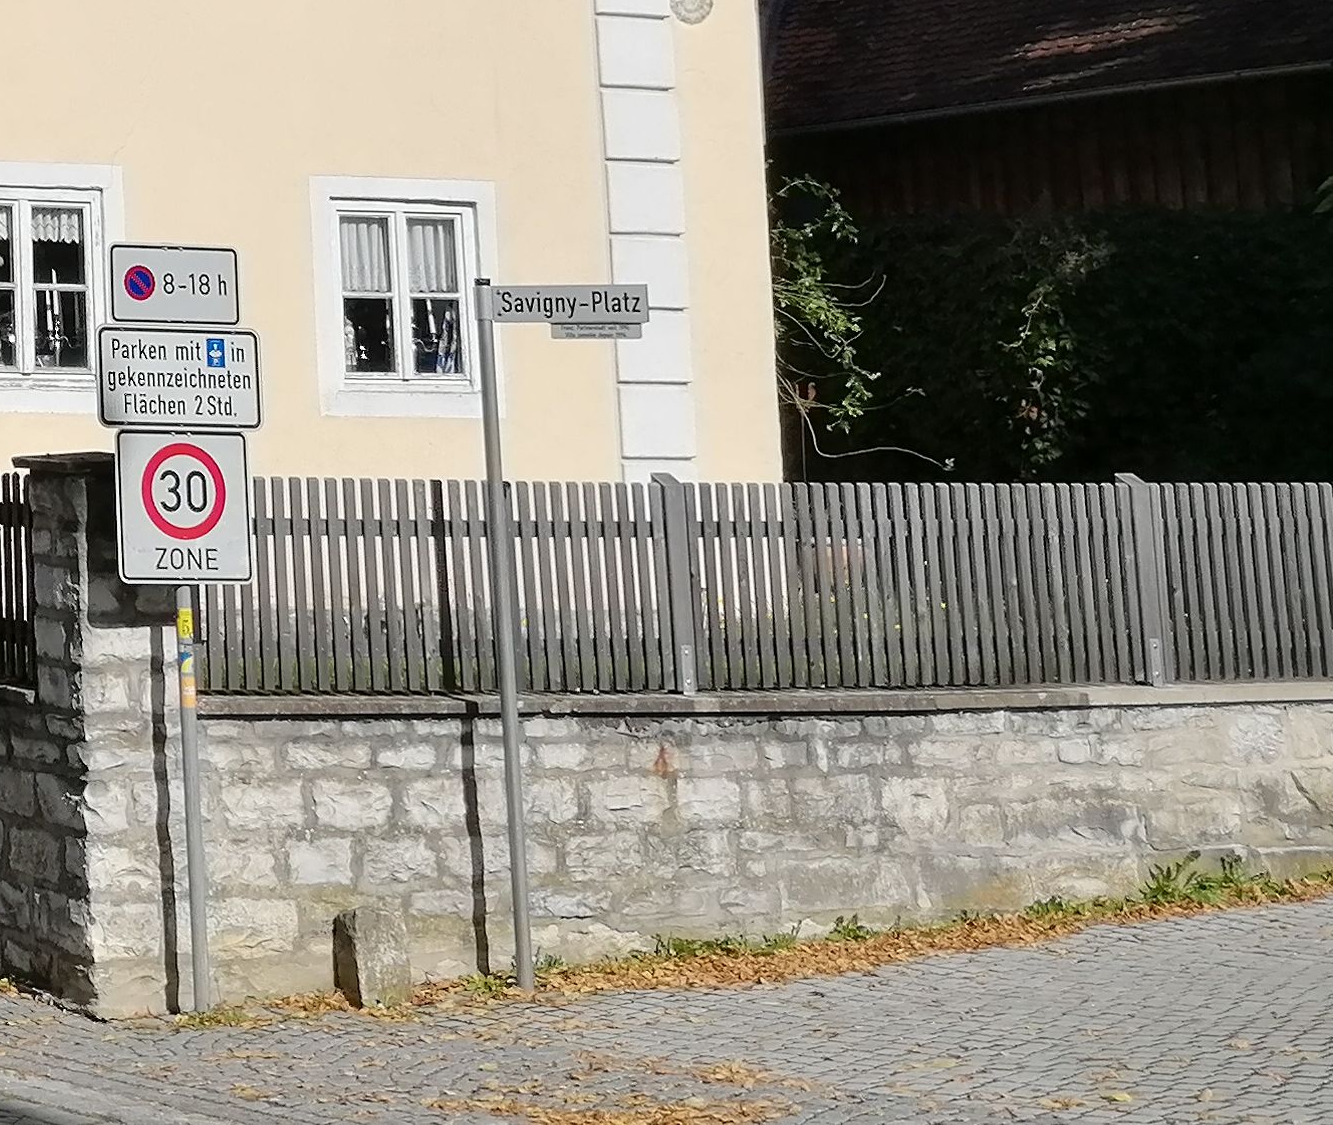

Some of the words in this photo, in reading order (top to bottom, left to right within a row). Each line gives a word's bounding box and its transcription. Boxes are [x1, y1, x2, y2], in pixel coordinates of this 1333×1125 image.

[163, 272, 211, 296] 8-18
[218, 273, 228, 296] h
[501, 290, 641, 319] Savigny-Platz
[111, 337, 167, 360] Parken
[175, 340, 202, 361] mit
[231, 341, 245, 363] in
[108, 366, 251, 392] gekennzeichneten
[124, 393, 186, 415] Flächen
[194, 394, 203, 416] 2
[207, 395, 238, 417] Std.
[159, 469, 207, 513] 30
[155, 547, 219, 571] ZONE
